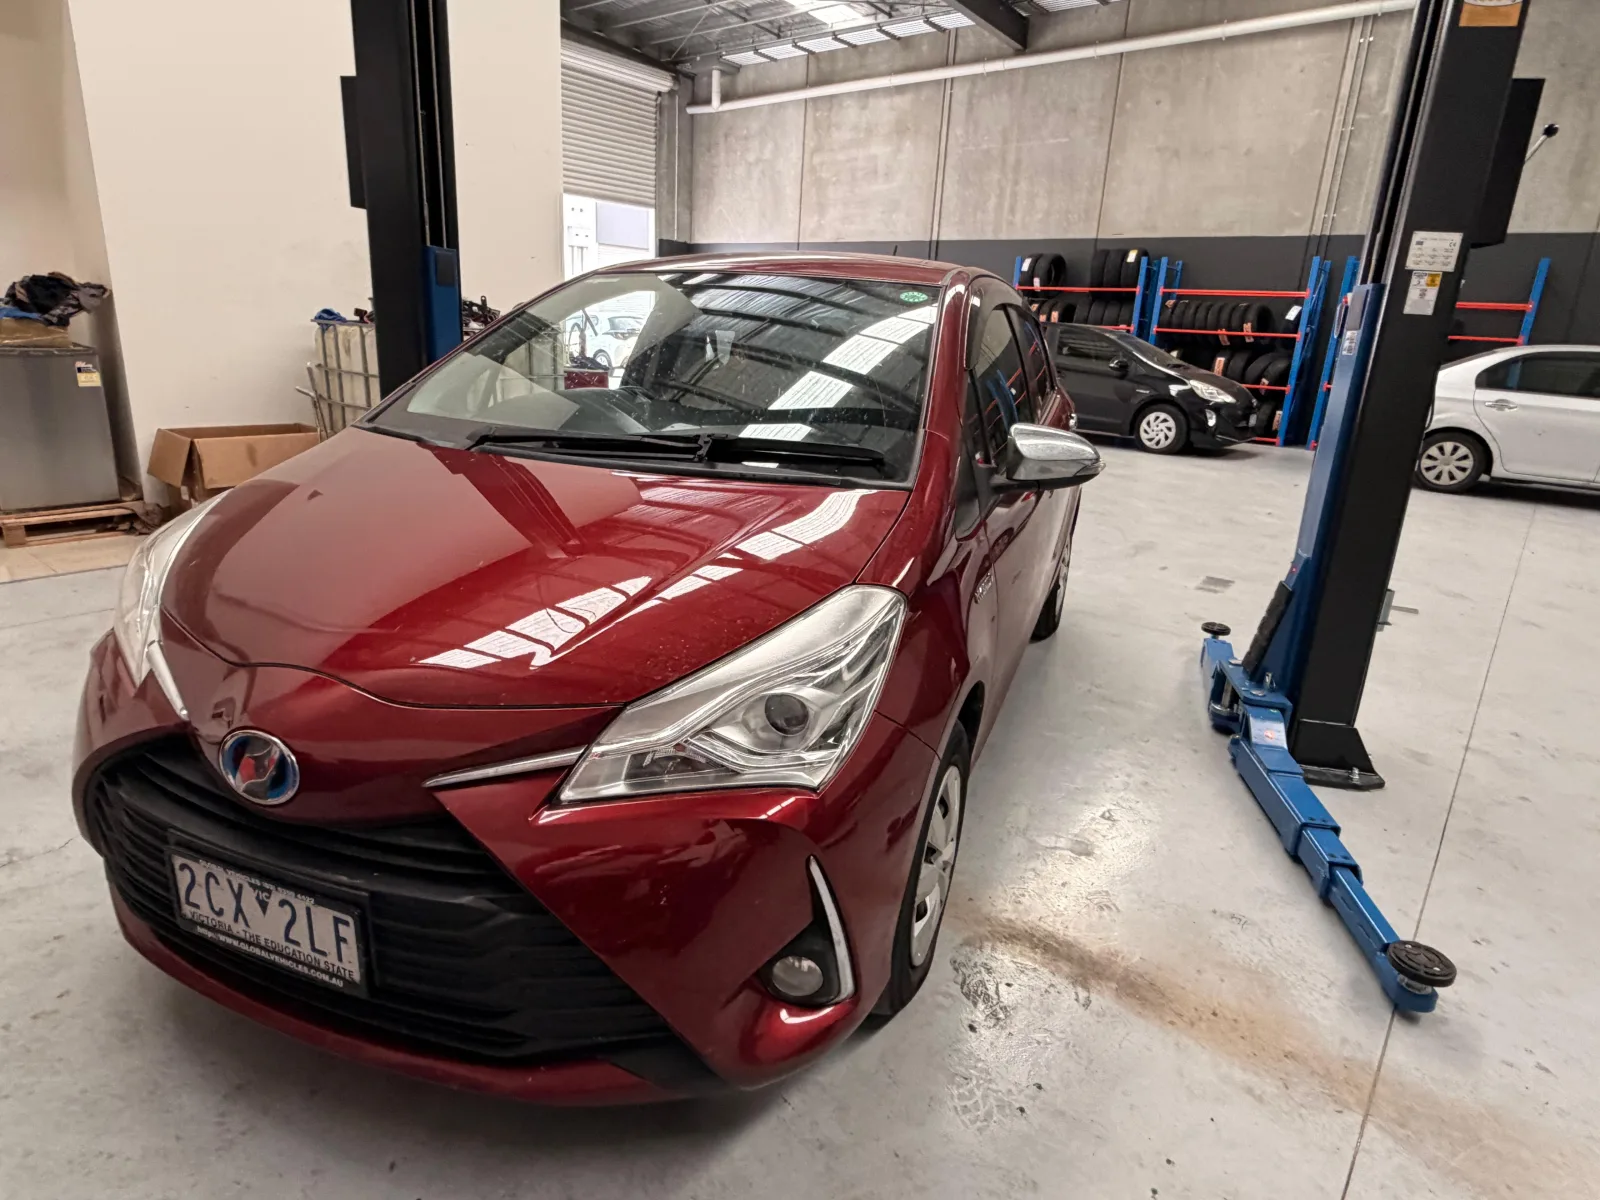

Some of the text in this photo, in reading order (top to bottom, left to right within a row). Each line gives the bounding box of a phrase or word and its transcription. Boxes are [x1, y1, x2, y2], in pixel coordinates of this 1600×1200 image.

[179, 862, 350, 964] 2CX 2LF
[252, 887, 271, 902] VIC
[189, 910, 234, 934] VICTORIA
[242, 928, 262, 945] THE
[263, 937, 321, 967] EDUCATION
[323, 960, 354, 979] STATE
